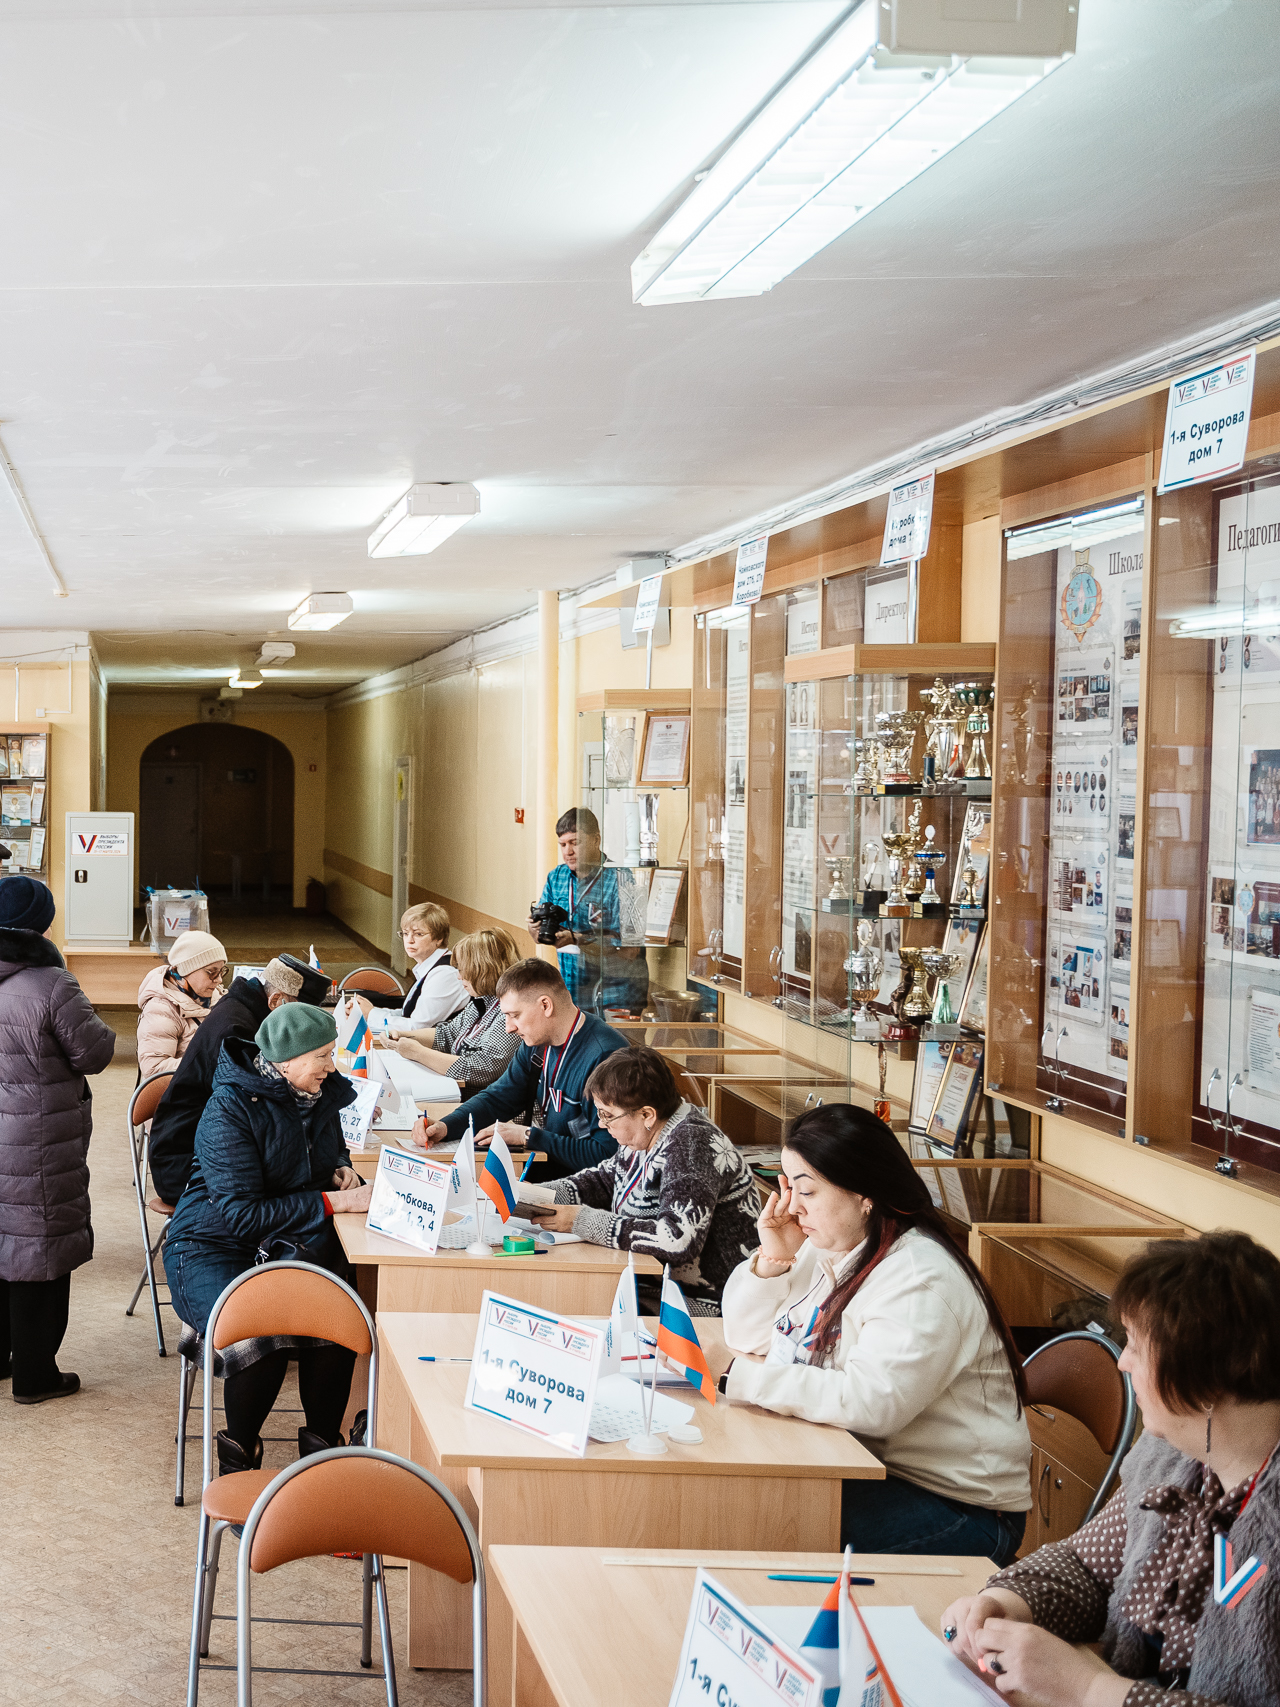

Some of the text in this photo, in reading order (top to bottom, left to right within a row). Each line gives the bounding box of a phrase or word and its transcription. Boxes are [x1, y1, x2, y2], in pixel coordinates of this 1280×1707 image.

[1170, 410, 1245, 445] 1-я Суворова
[1187, 438, 1223, 466] дом 7
[1108, 551, 1144, 576] Школа
[428, 1220, 435, 1232] 4
[482, 1348, 586, 1403] 1-я Суворова
[505, 1387, 553, 1414] дом 7
[690, 1657, 712, 1696] 1-я
